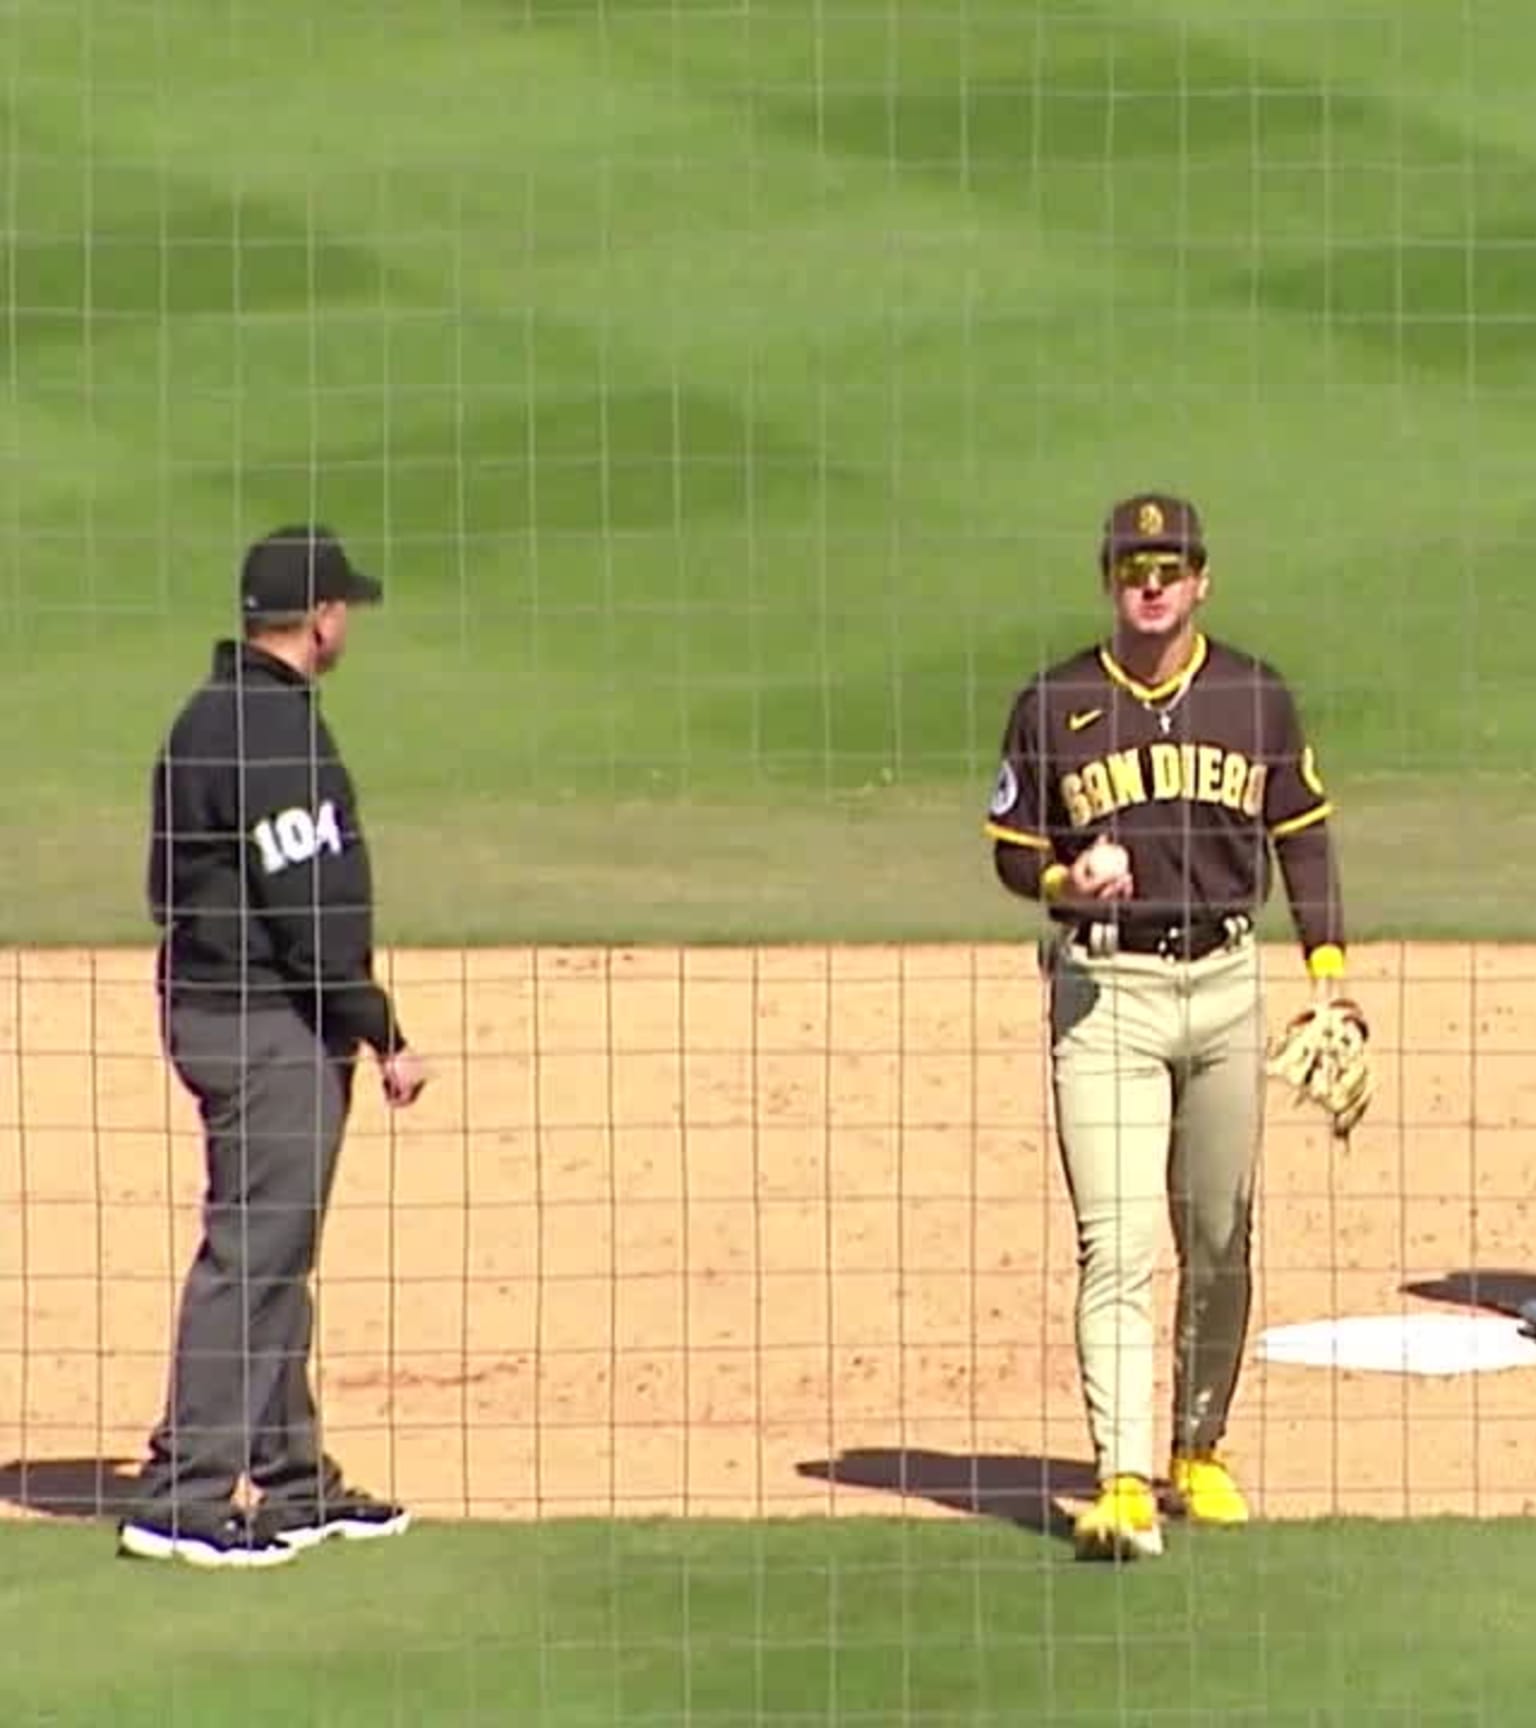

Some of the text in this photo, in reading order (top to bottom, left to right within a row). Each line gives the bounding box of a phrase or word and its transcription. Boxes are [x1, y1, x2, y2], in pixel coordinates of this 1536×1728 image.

[1061, 743, 1267, 827] SAN DIEGO
[254, 800, 341, 874] 104
